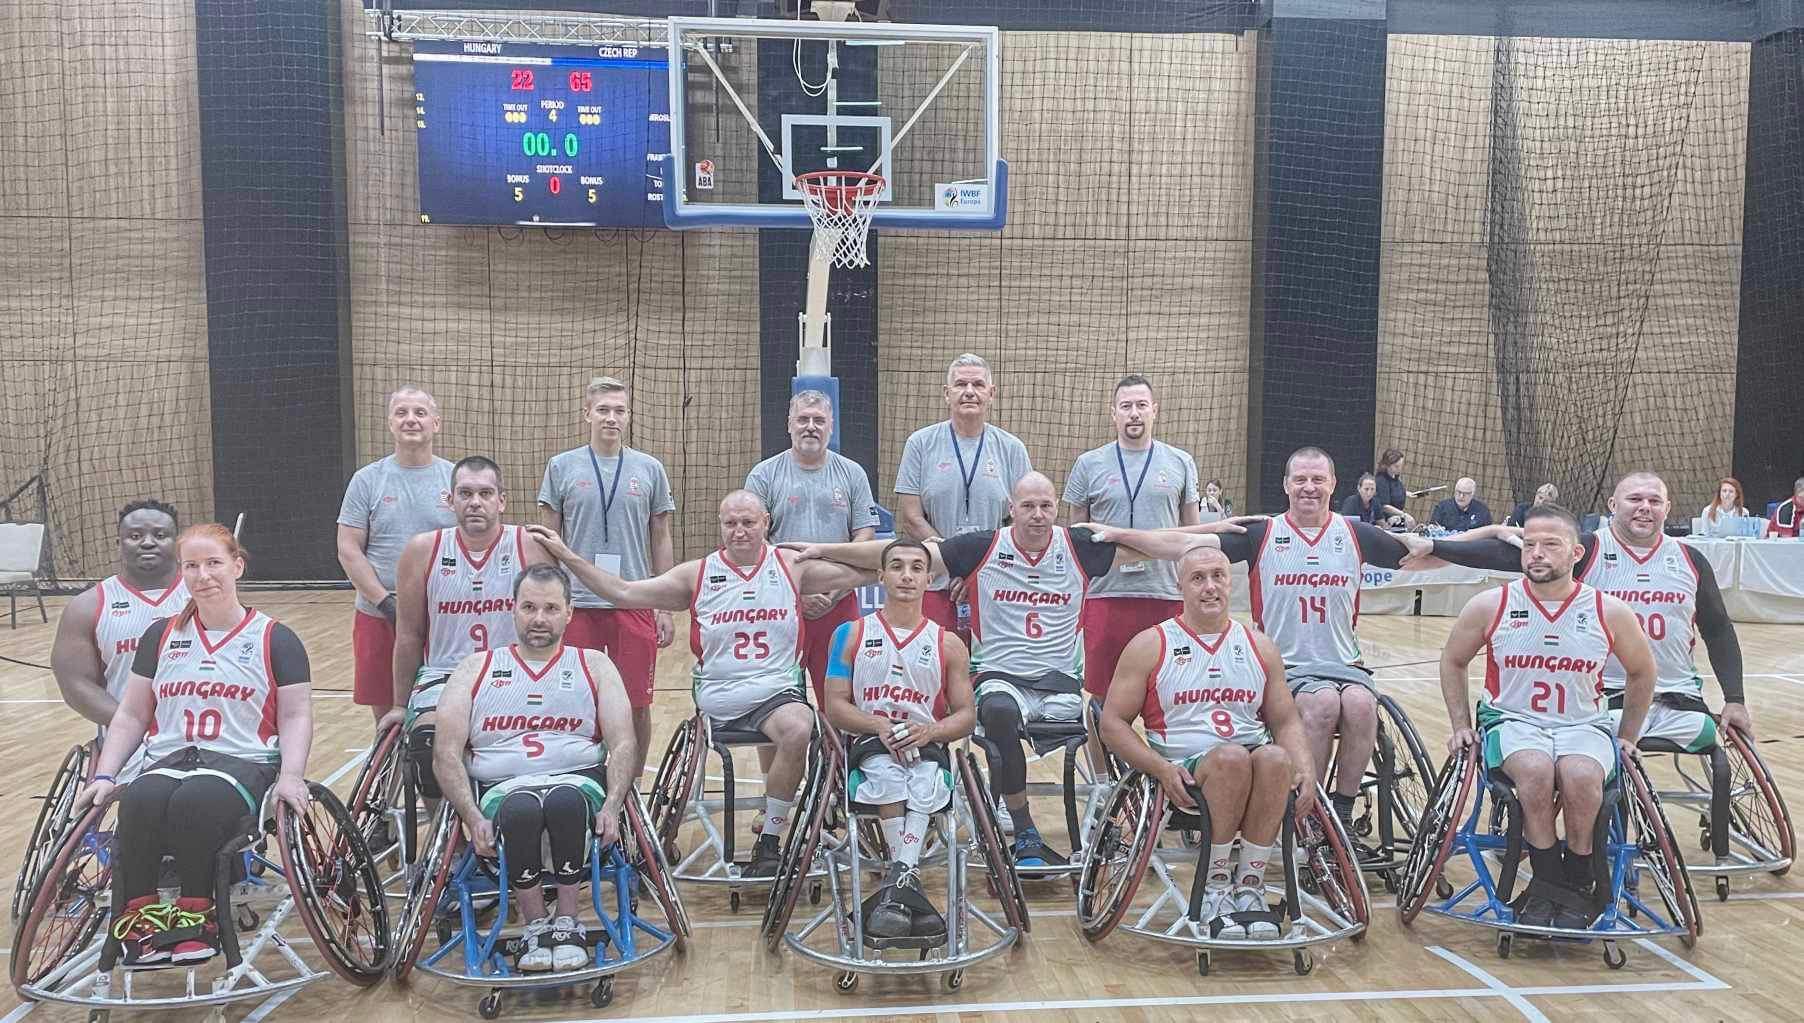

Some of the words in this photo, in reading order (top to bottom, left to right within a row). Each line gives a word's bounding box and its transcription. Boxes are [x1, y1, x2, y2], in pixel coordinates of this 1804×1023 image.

[463, 42, 502, 54] HUNGARY
[598, 47, 622, 58] CZECH
[623, 48, 638, 58] REP
[511, 70, 534, 90] 22
[569, 71, 593, 92] 65
[540, 100, 565, 109] PERIOD
[548, 109, 557, 122] 4
[536, 165, 573, 174] SHOTCLOCK
[506, 174, 529, 184] BONUS
[549, 176, 560, 194] 0
[580, 176, 604, 185] BONUS
[698, 176, 712, 187] ABA
[513, 187, 524, 202] 5
[588, 189, 597, 204] 5
[960, 190, 981, 198] IWBF
[1273, 573, 1349, 588] HUNGARY
[855, 586, 886, 609] LL
[993, 589, 1072, 606] HUNGARY
[438, 598, 514, 616] HUNGARY
[711, 607, 788, 625] HUNGARY
[1299, 596, 1326, 624] 14
[1025, 612, 1044, 639] 6
[470, 623, 488, 653] 9
[734, 631, 770, 660] 25
[1504, 654, 1597, 674] HUNGARY
[160, 680, 256, 702] HUNGARY
[1174, 687, 1257, 705] HUNGARY
[1531, 681, 1566, 714] 21
[184, 708, 223, 741] 10
[482, 714, 583, 732] HUNGARY
[522, 732, 545, 758] 5
[506, 940, 522, 953] RG
